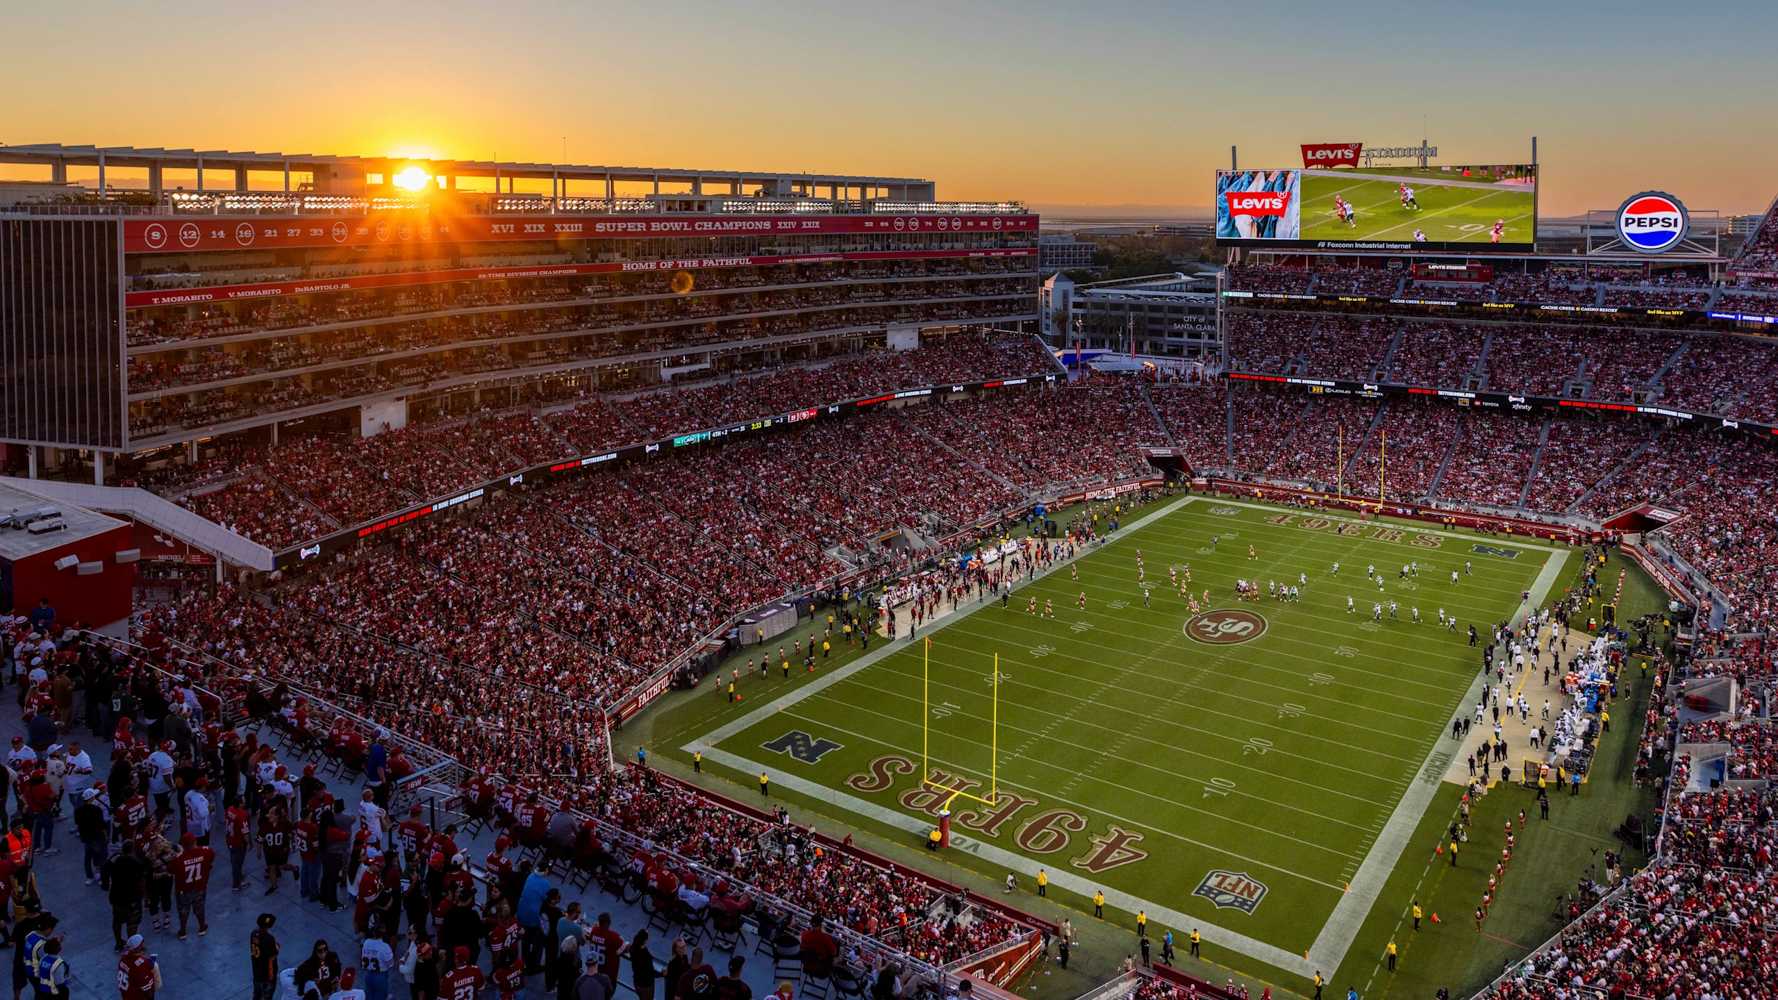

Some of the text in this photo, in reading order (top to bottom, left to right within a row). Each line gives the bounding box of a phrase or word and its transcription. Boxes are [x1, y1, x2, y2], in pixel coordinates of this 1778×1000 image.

[595, 220, 771, 232] SUPER BOWL CHAMPIONS
[1624, 217, 1678, 228] PEPSI
[1355, 241, 1385, 249] Industrial
[622, 257, 752, 271] HOME OF THE FAITHFUL
[1183, 315, 1197, 323] CITY
[1196, 323, 1215, 331] CLARA
[1263, 513, 1446, 550] 49ERS
[637, 675, 672, 707] FAITHFUL
[1201, 776, 1237, 799] 10
[128, 810, 146, 826] 54
[844, 755, 1150, 874] 49ERS
[265, 831, 284, 847] 80
[185, 863, 203, 884] 71
[1213, 872, 1262, 900] NFL
[453, 985, 475, 1000] 23
